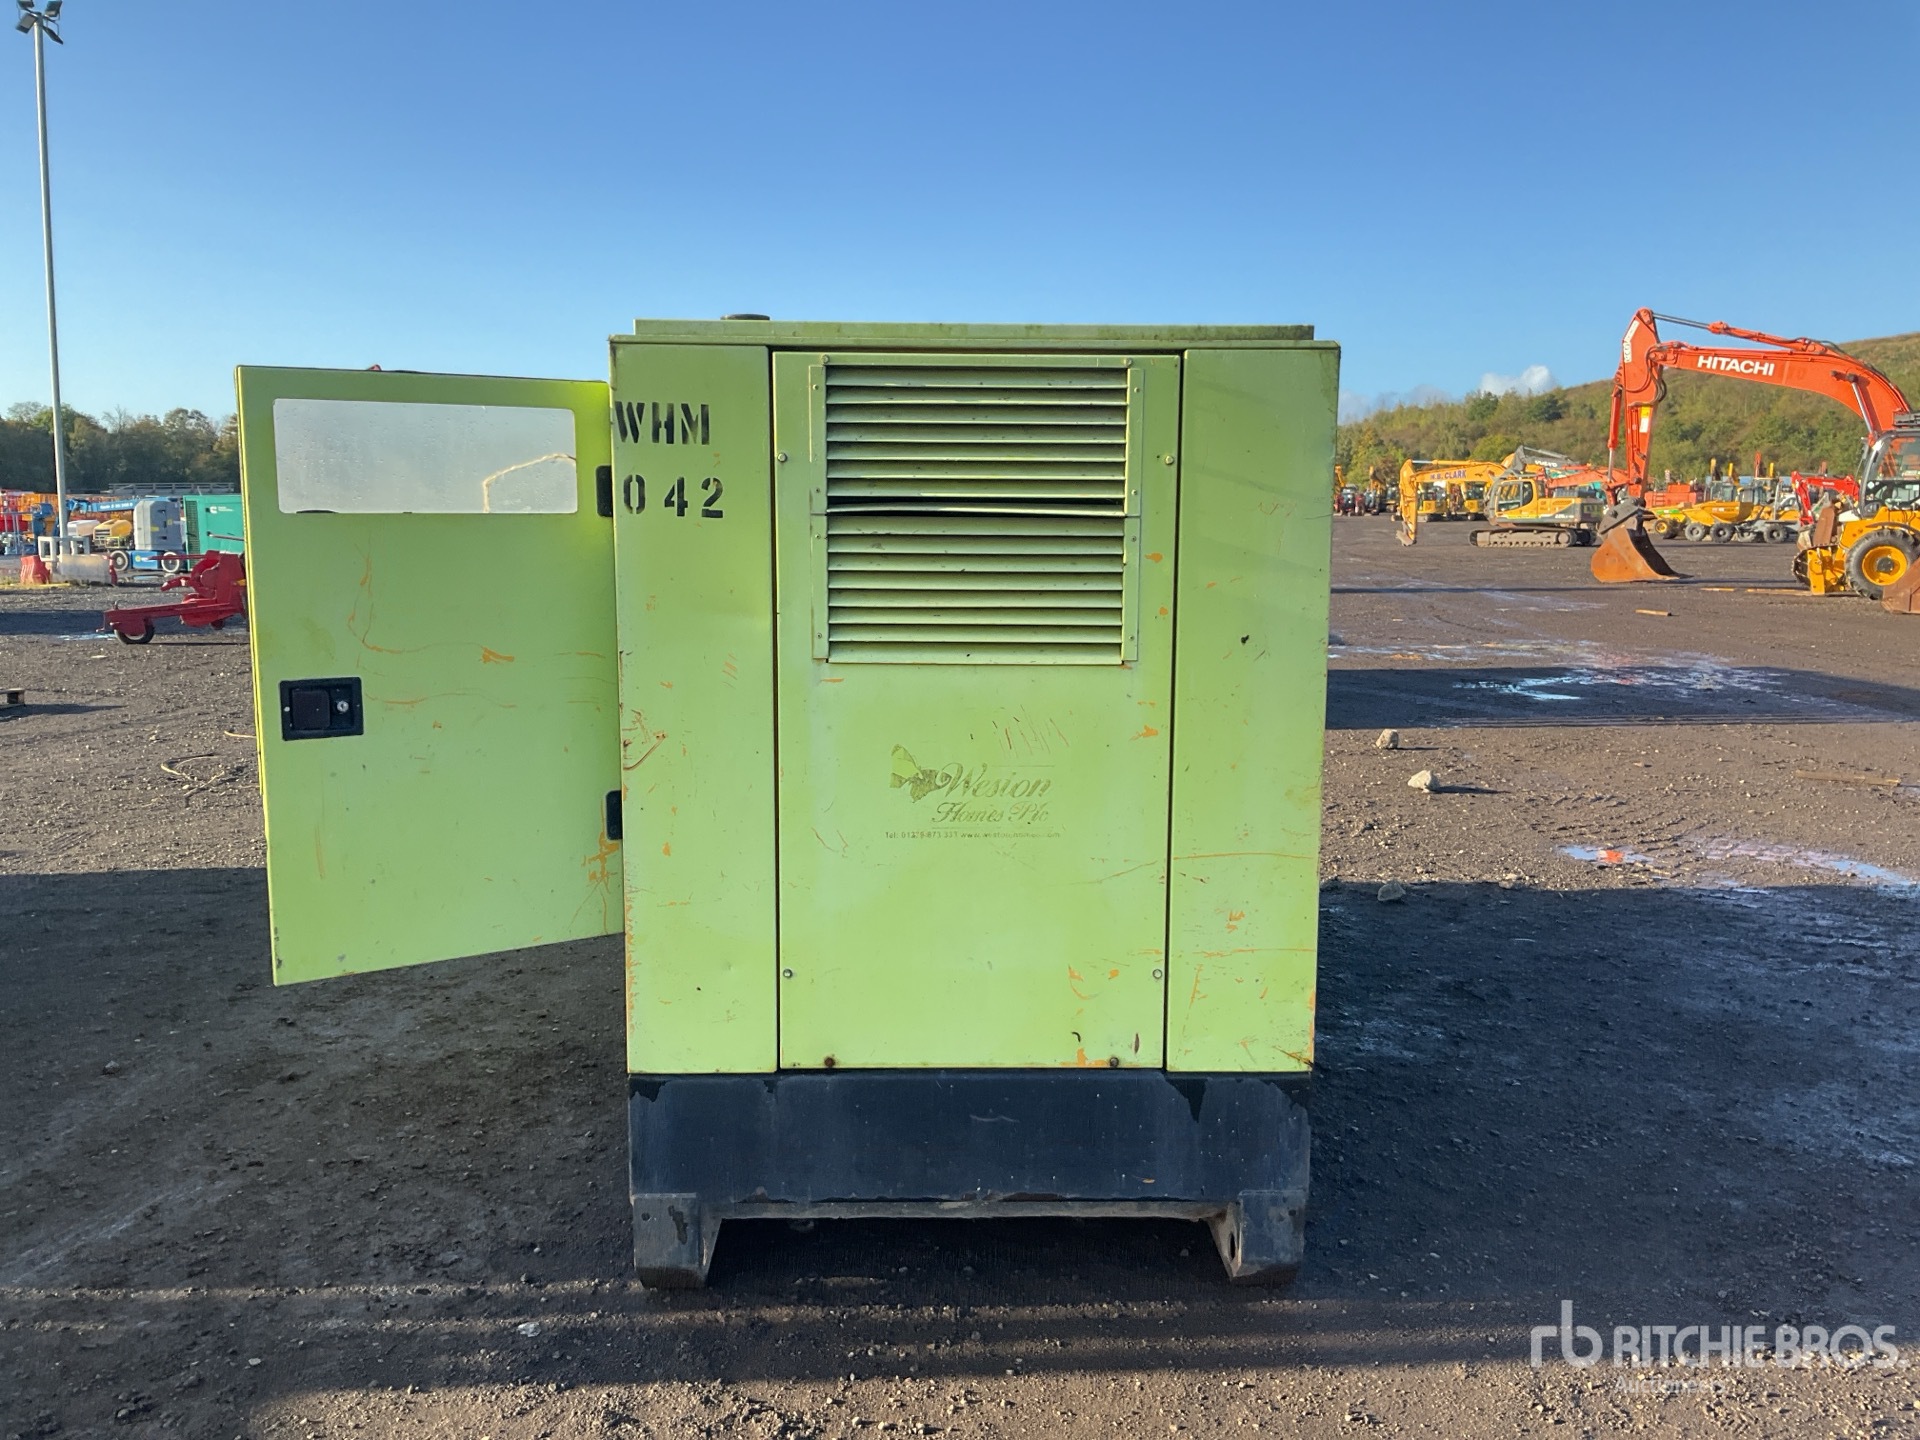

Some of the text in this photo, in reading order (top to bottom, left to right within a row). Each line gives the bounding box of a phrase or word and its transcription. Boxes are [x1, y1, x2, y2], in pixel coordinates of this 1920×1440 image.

[1697, 355, 1775, 376] HITACHI
[614, 401, 710, 445] WHM
[1445, 469, 1467, 479] CLARK
